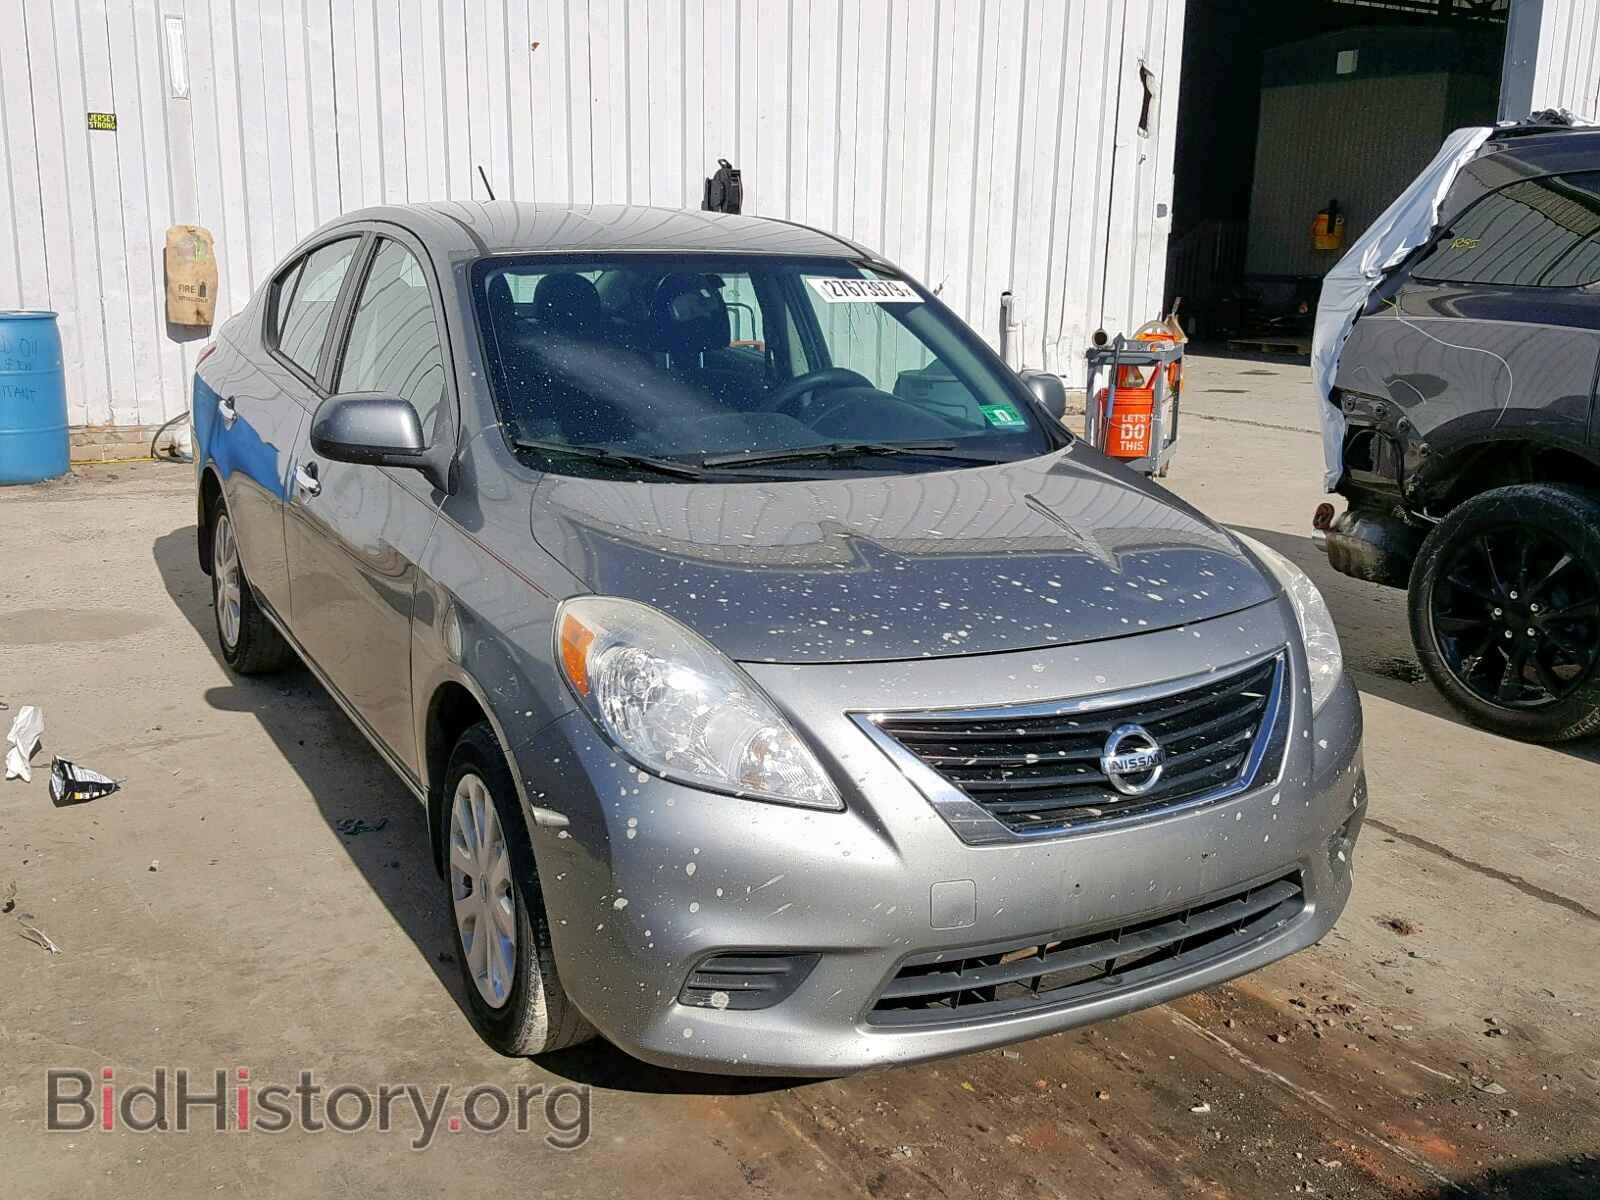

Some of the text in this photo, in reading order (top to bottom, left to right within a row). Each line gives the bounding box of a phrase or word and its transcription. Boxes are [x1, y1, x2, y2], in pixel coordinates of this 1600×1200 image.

[89, 114, 115, 122] JERSEY
[178, 284, 197, 294] FIRE
[823, 280, 906, 297] 27673979
[1120, 423, 1145, 440] DO
[1111, 748, 1166, 770] NISSAN
